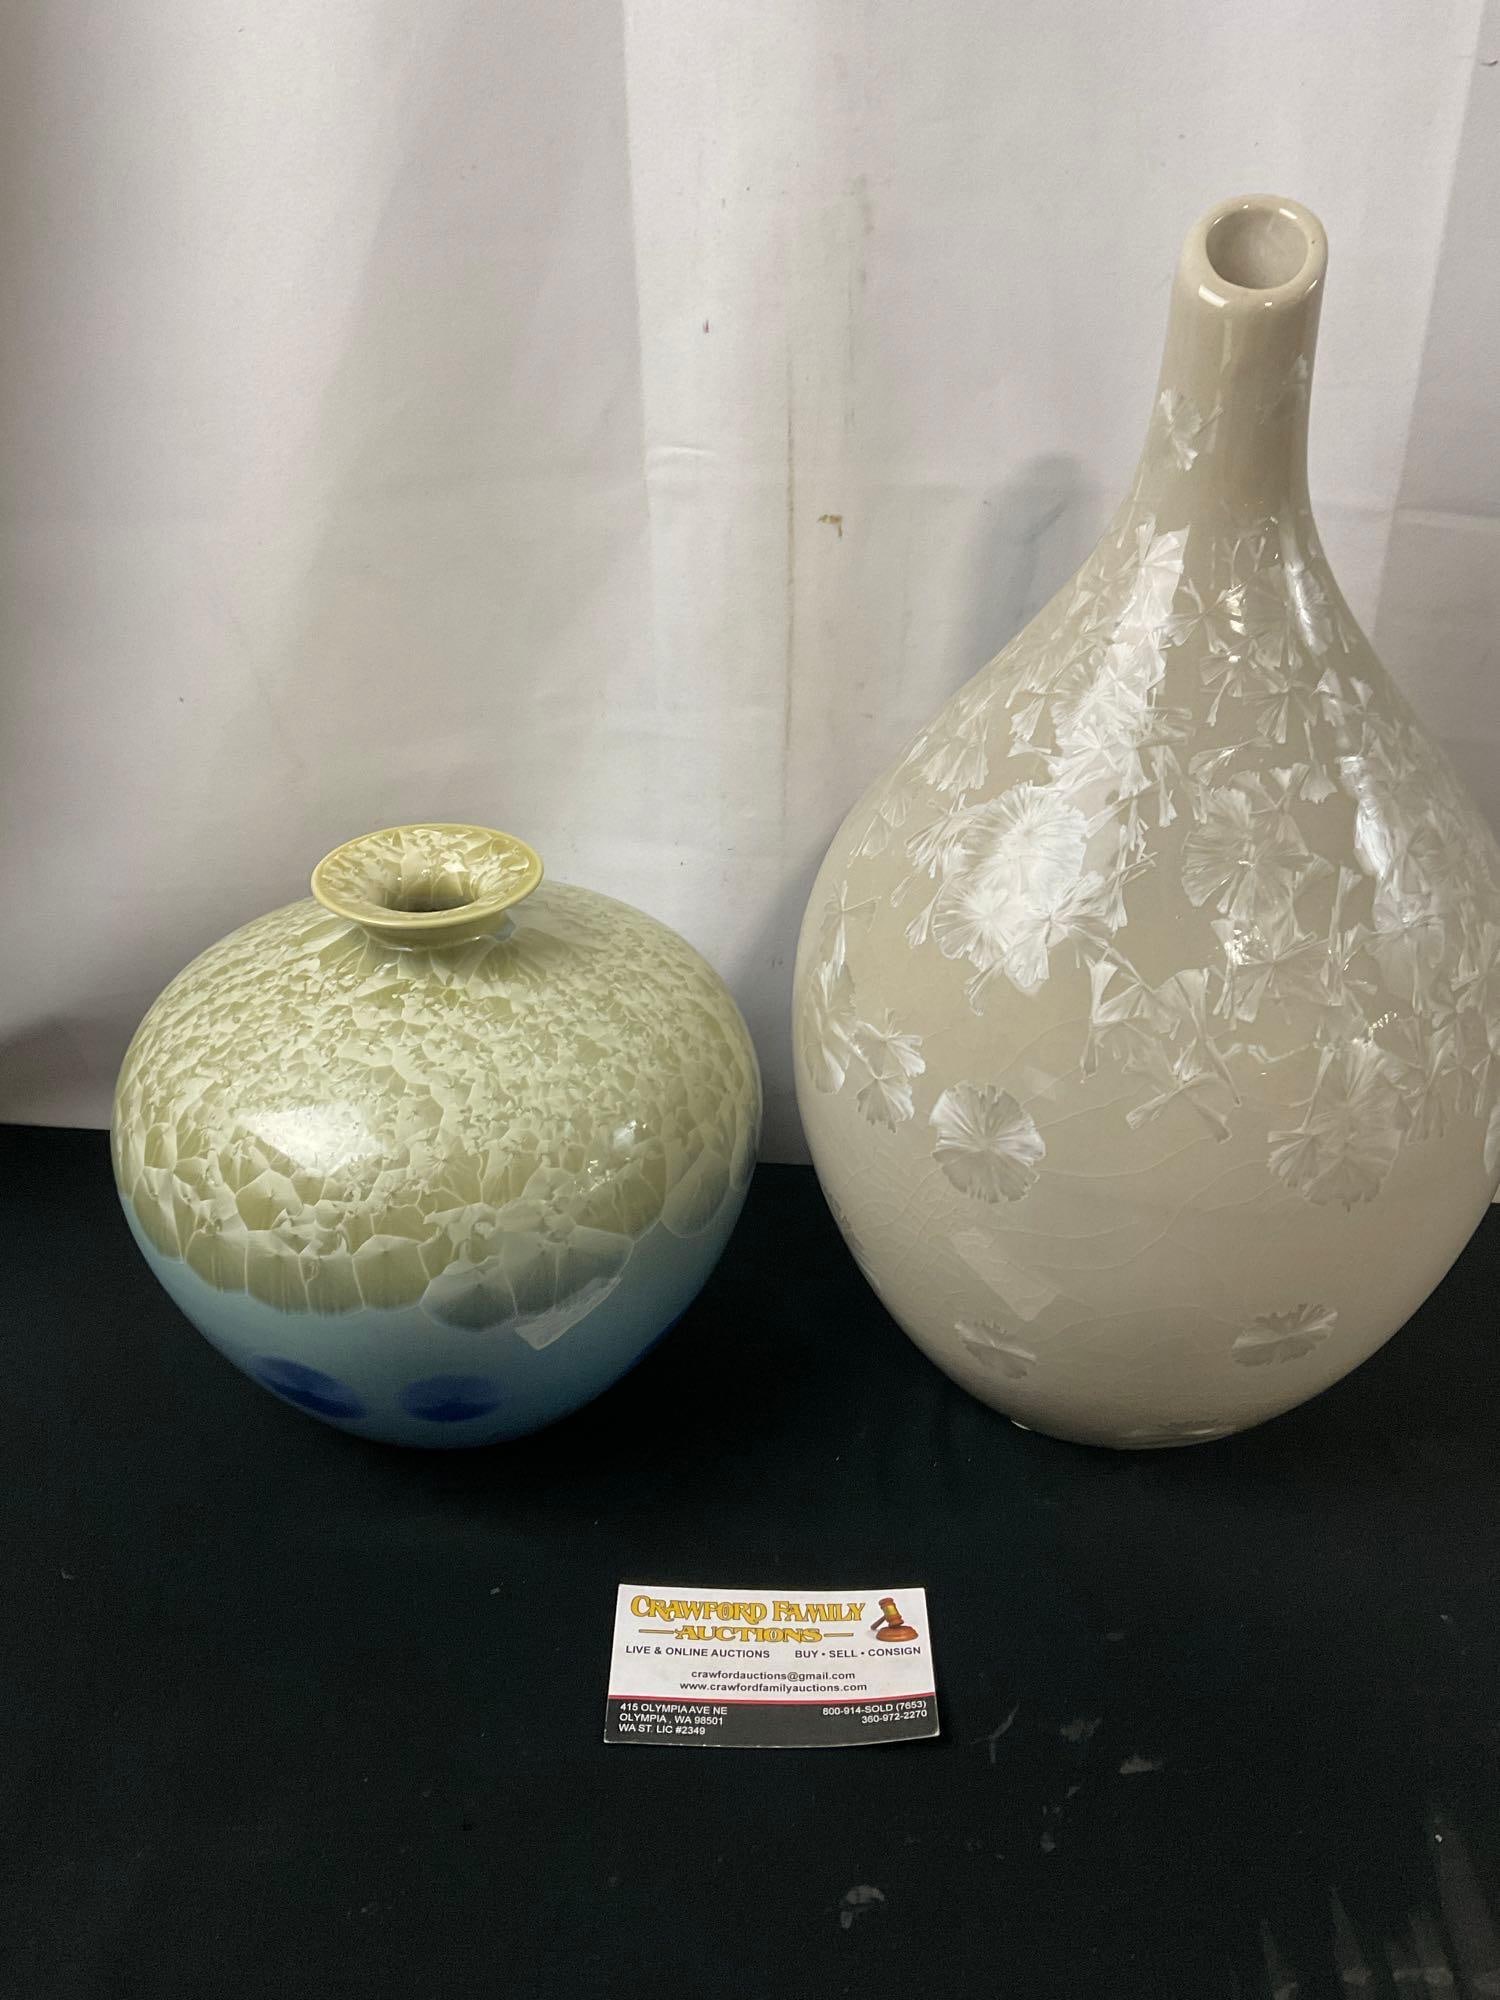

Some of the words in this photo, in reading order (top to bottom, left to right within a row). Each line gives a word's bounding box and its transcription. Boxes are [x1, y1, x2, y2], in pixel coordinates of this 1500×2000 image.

[630, 1594, 768, 1625] CRAWFORD
[772, 1600, 866, 1624] FAMILY
[674, 1625, 823, 1644] AUCTIONS
[625, 1645, 651, 1655] LIVE
[654, 1646, 662, 1655] &
[665, 1646, 708, 1657] ONLINE
[711, 1648, 770, 1659] AUCTIONS
[794, 1649, 819, 1659] BUY
[829, 1649, 858, 1658] SELL
[868, 1646, 921, 1657] CONSIGN
[691, 1670, 856, 1682] crawfordauctions@gmail.com
[679, 1682, 868, 1694] www.crawfordfamilyauctions.com
[620, 1702, 639, 1712] 415
[640, 1703, 688, 1714] OLYMPIA
[688, 1705, 710, 1715] AVE
[712, 1706, 728, 1715] NE
[895, 1700, 927, 1712] (7653)
[674, 1715, 692, 1724] WA
[694, 1716, 723, 1726] 98501
[861, 1709, 928, 1724] 360-972-2270
[618, 1723, 636, 1732] WA
[656, 1725, 673, 1734] LIC
[675, 1726, 706, 1735] #2349
